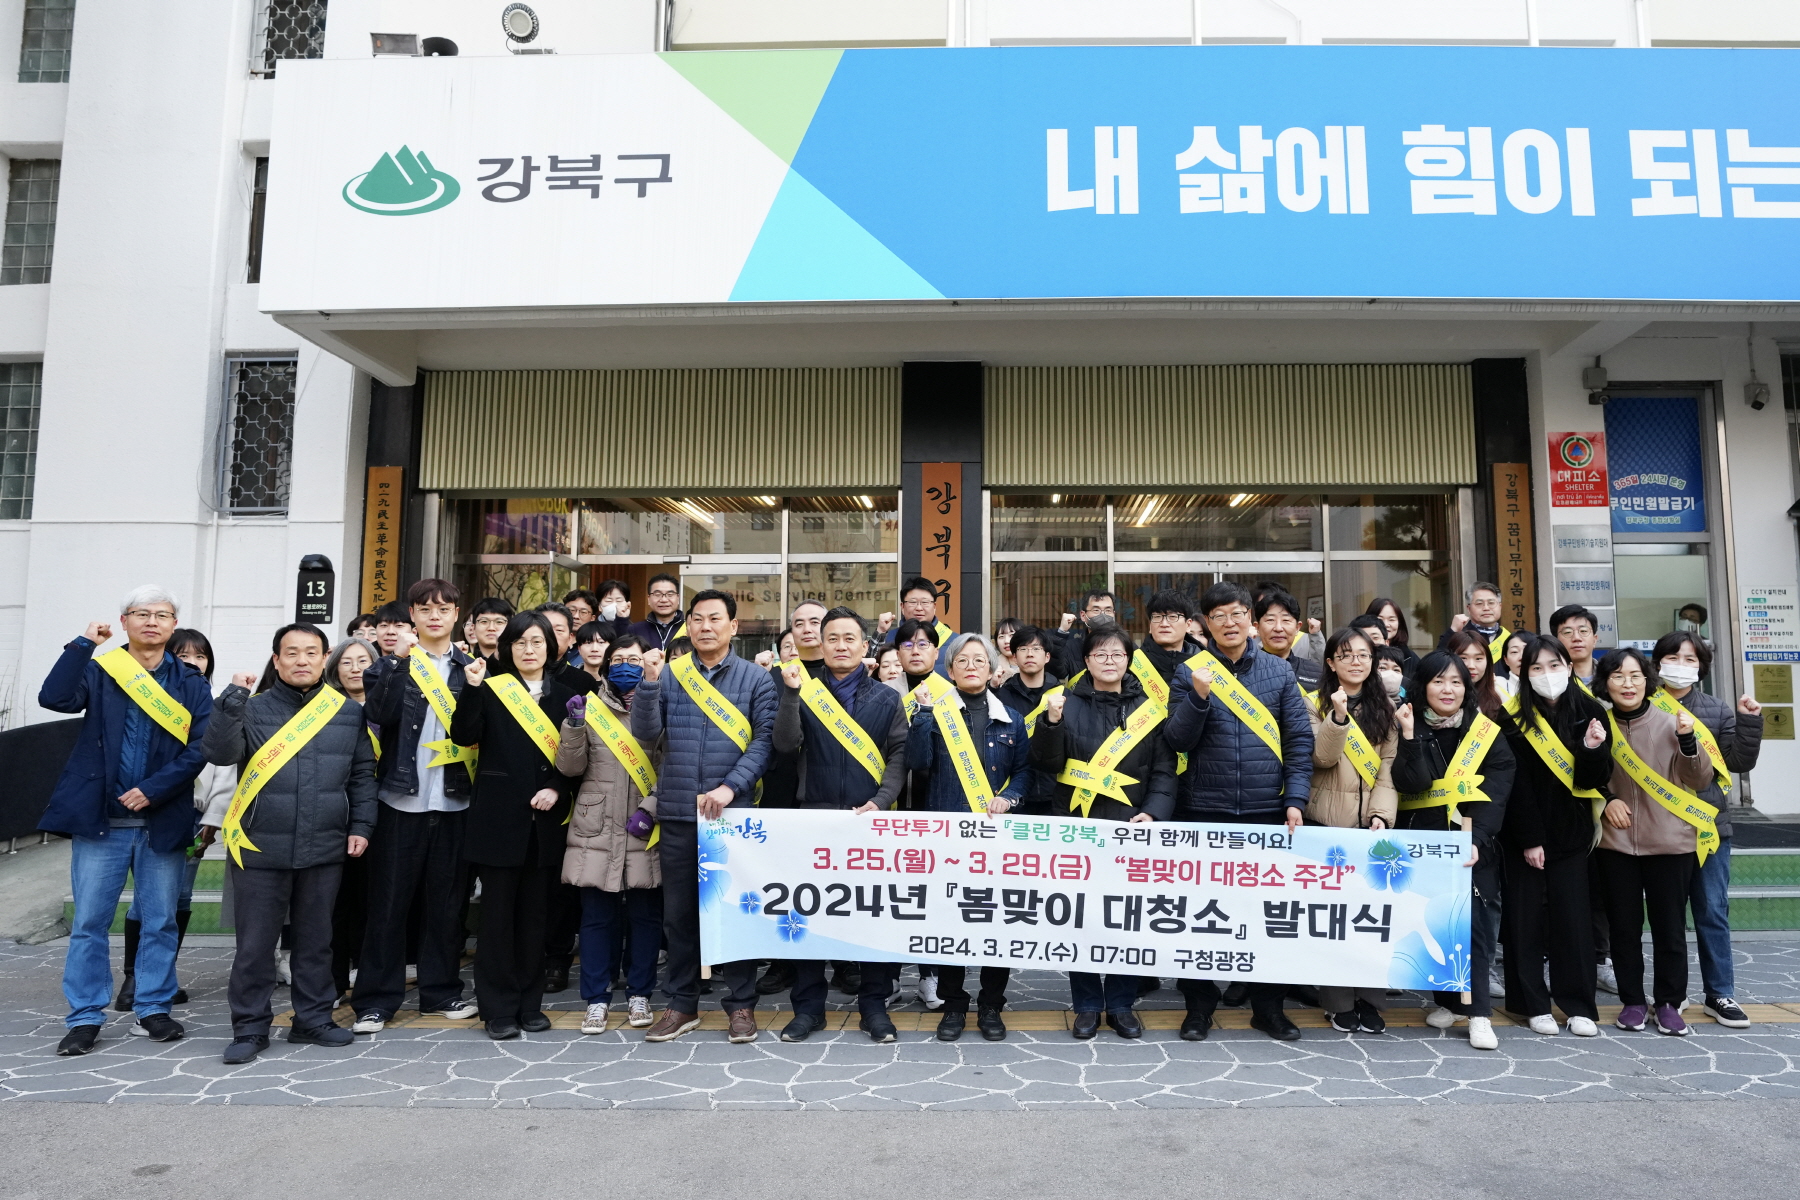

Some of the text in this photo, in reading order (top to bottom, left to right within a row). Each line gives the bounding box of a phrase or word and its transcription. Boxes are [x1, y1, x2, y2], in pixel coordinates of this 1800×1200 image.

[476, 152, 673, 203] 강북구
[1046, 124, 1800, 219] 내 삶에 힘이 되는
[1557, 470, 1601, 482] 대피소
[1565, 483, 1595, 491] SHELTER
[1613, 474, 1639, 490] 365일
[1640, 473, 1668, 485] 24시간
[1505, 473, 1520, 518] 강북구
[1610, 496, 1695, 511] 무인민원발급기
[926, 482, 957, 629] 강북구
[1507, 522, 1524, 596] 꿈나무키움
[306, 581, 326, 597] 13
[834, 590, 891, 601] Center
[688, 677, 704, 697] 쓰레기
[817, 698, 835, 717] 쓰레기
[257, 743, 286, 770] 쓰레기는
[617, 740, 640, 767] 쓰레기는
[1622, 753, 1640, 773] 쓰레기
[735, 817, 767, 843] 강북
[871, 818, 1293, 850] 무단투기 없는 『클린 강북』 우리 함께 만들어요!
[1407, 843, 1461, 860] 강북구
[813, 847, 839, 872] 3.
[968, 851, 994, 875] 3.
[1114, 855, 1201, 886] “봄맞이
[1210, 861, 1286, 888] 대청소
[1293, 863, 1356, 891] 주간”
[761, 881, 1393, 944] 2024년 『봄맞이 대청소』 발대식
[908, 935, 1257, 973] 2024. 3. 27.(수) 07:00 구청광장
